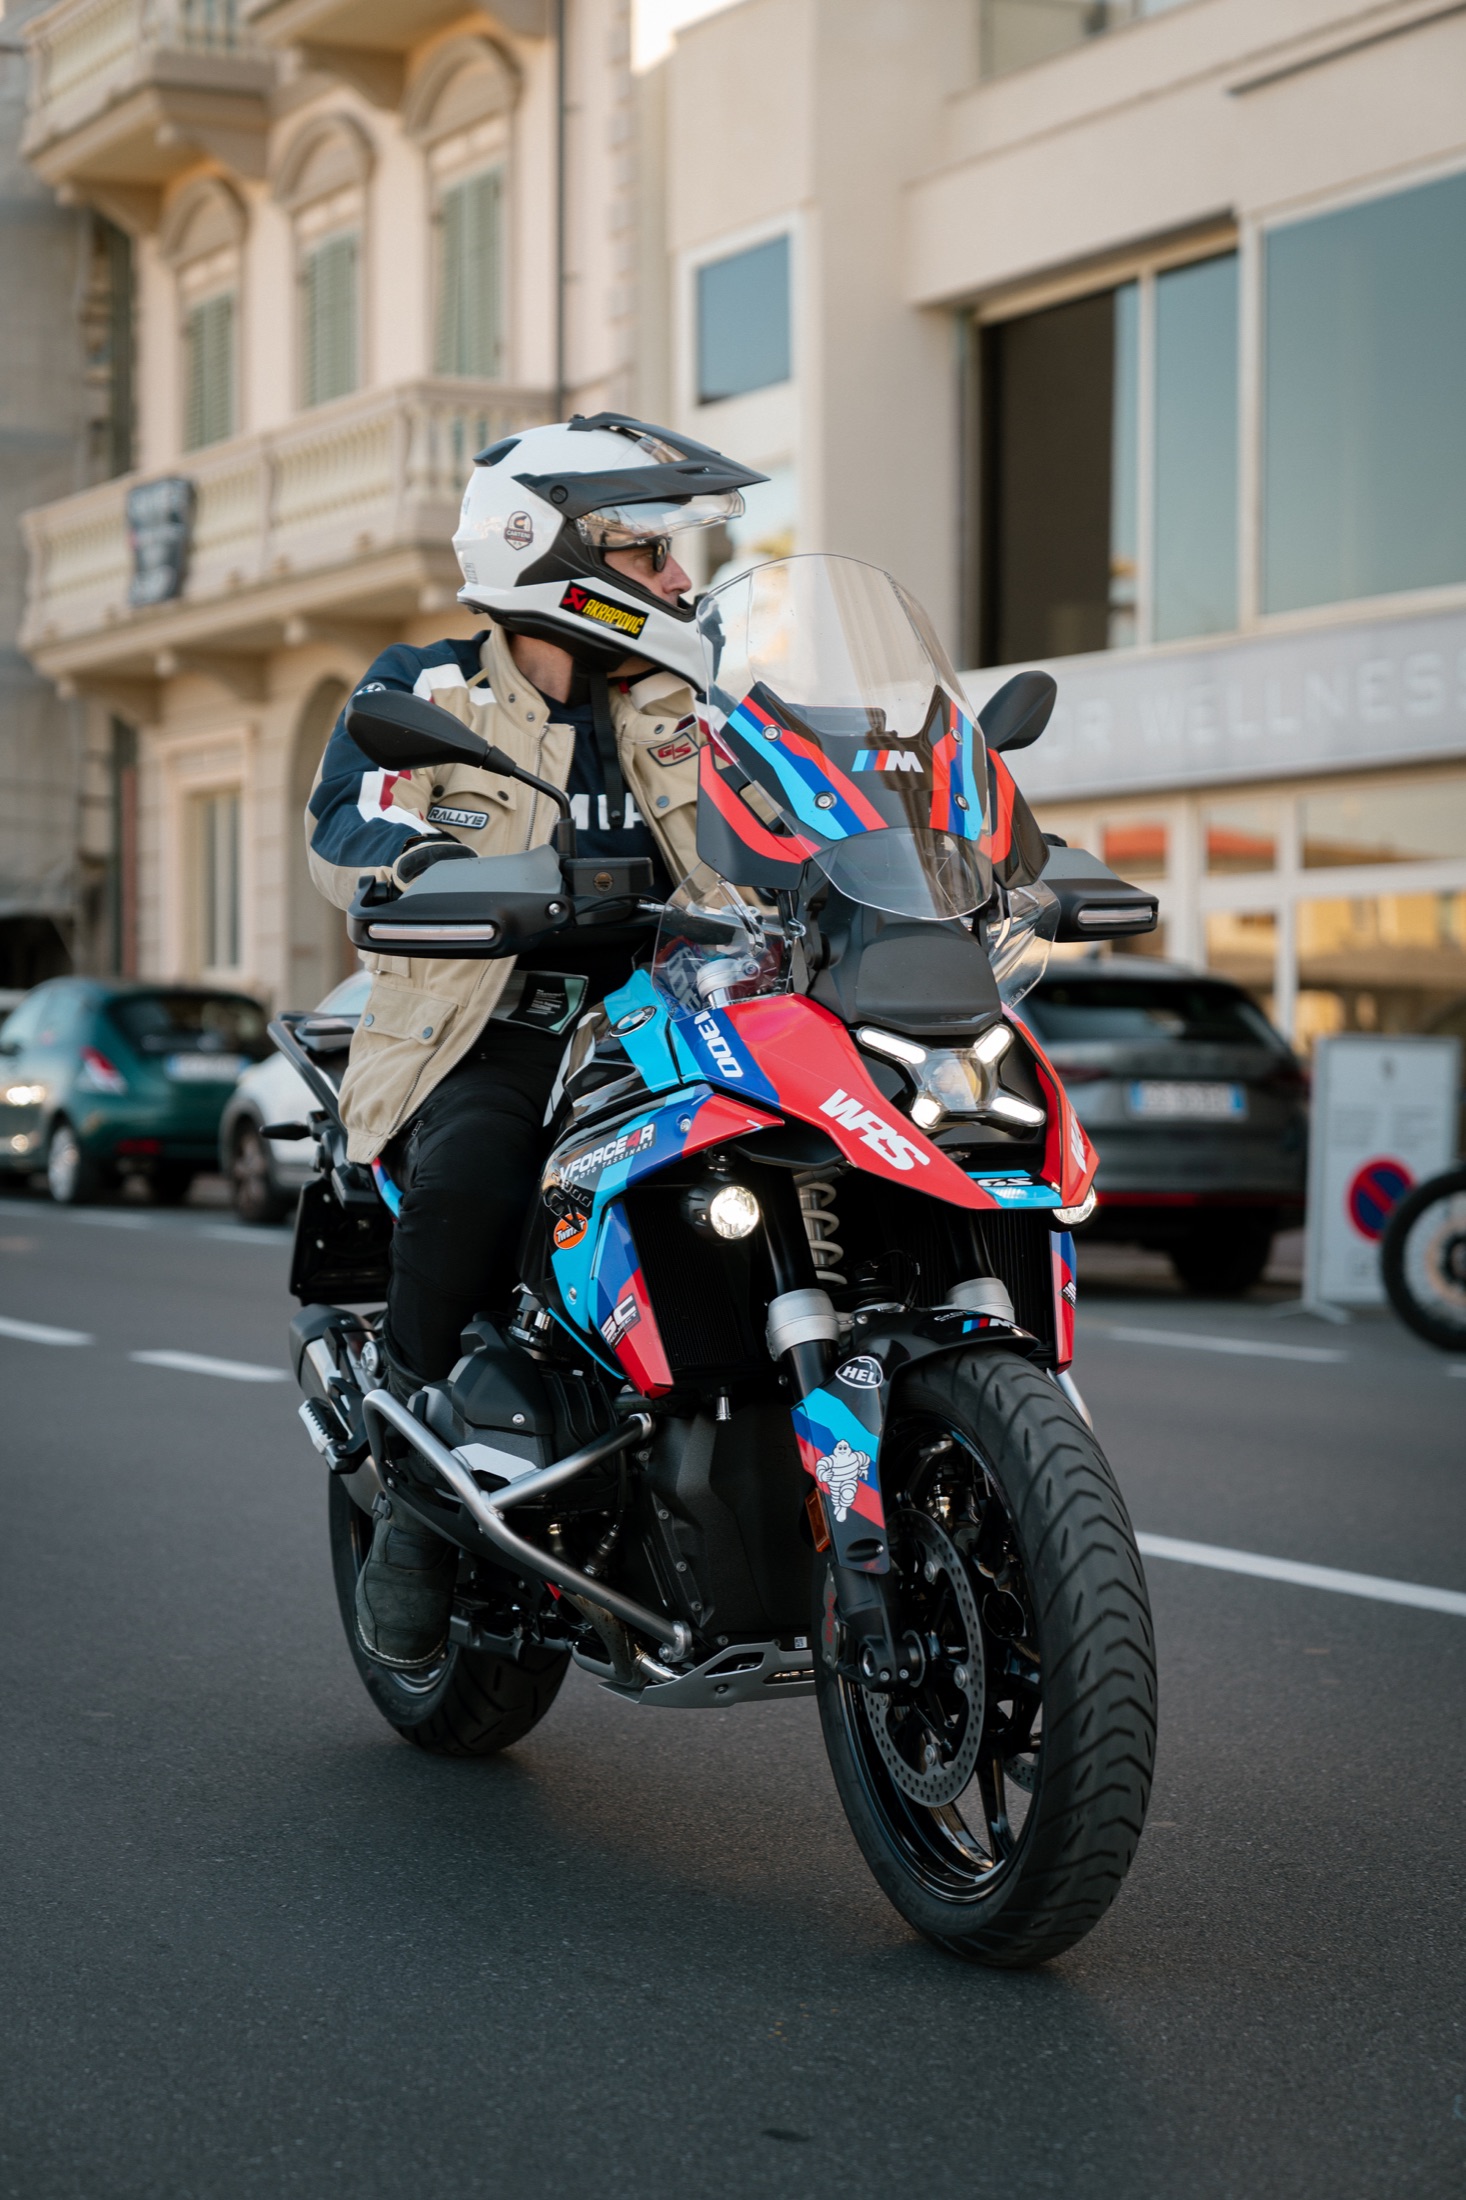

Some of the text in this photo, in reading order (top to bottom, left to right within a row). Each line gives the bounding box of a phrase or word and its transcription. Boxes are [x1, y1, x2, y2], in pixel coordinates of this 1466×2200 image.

[1139, 650, 1466, 746] WELLNES
[430, 809, 485, 826] RALLYE
[694, 1010, 744, 1077] 1300
[818, 1088, 930, 1170] WRS
[573, 1140, 654, 1182] MOTO TASSINARI
[977, 1178, 1033, 1187] GS
[600, 1295, 637, 1342] SC
[842, 1366, 877, 1384] HEL
